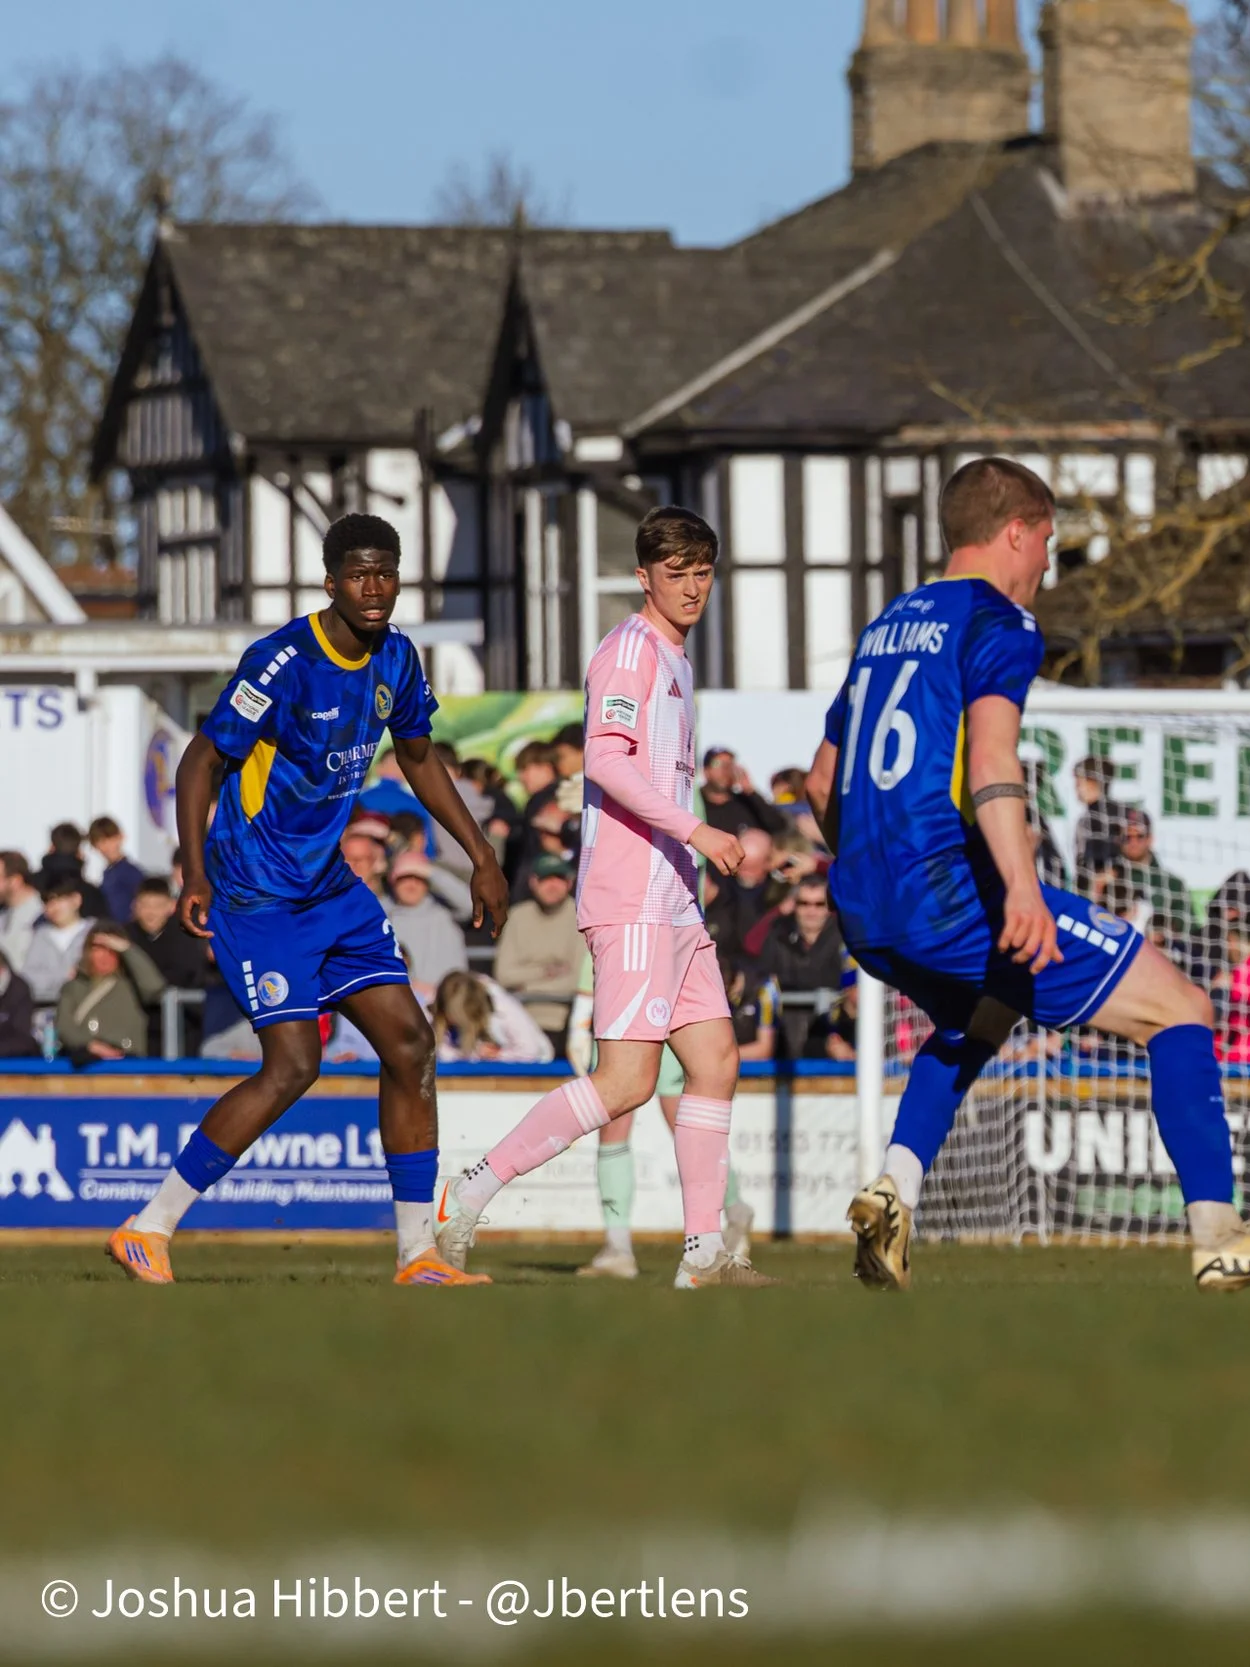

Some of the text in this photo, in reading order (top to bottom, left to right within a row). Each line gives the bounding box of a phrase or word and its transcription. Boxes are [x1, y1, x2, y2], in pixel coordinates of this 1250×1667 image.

[856, 621, 949, 660] WILLIAMS
[842, 660, 919, 796] 16
[78, 1123, 172, 1168] T.M.
[346, 1123, 387, 1168] Lt
